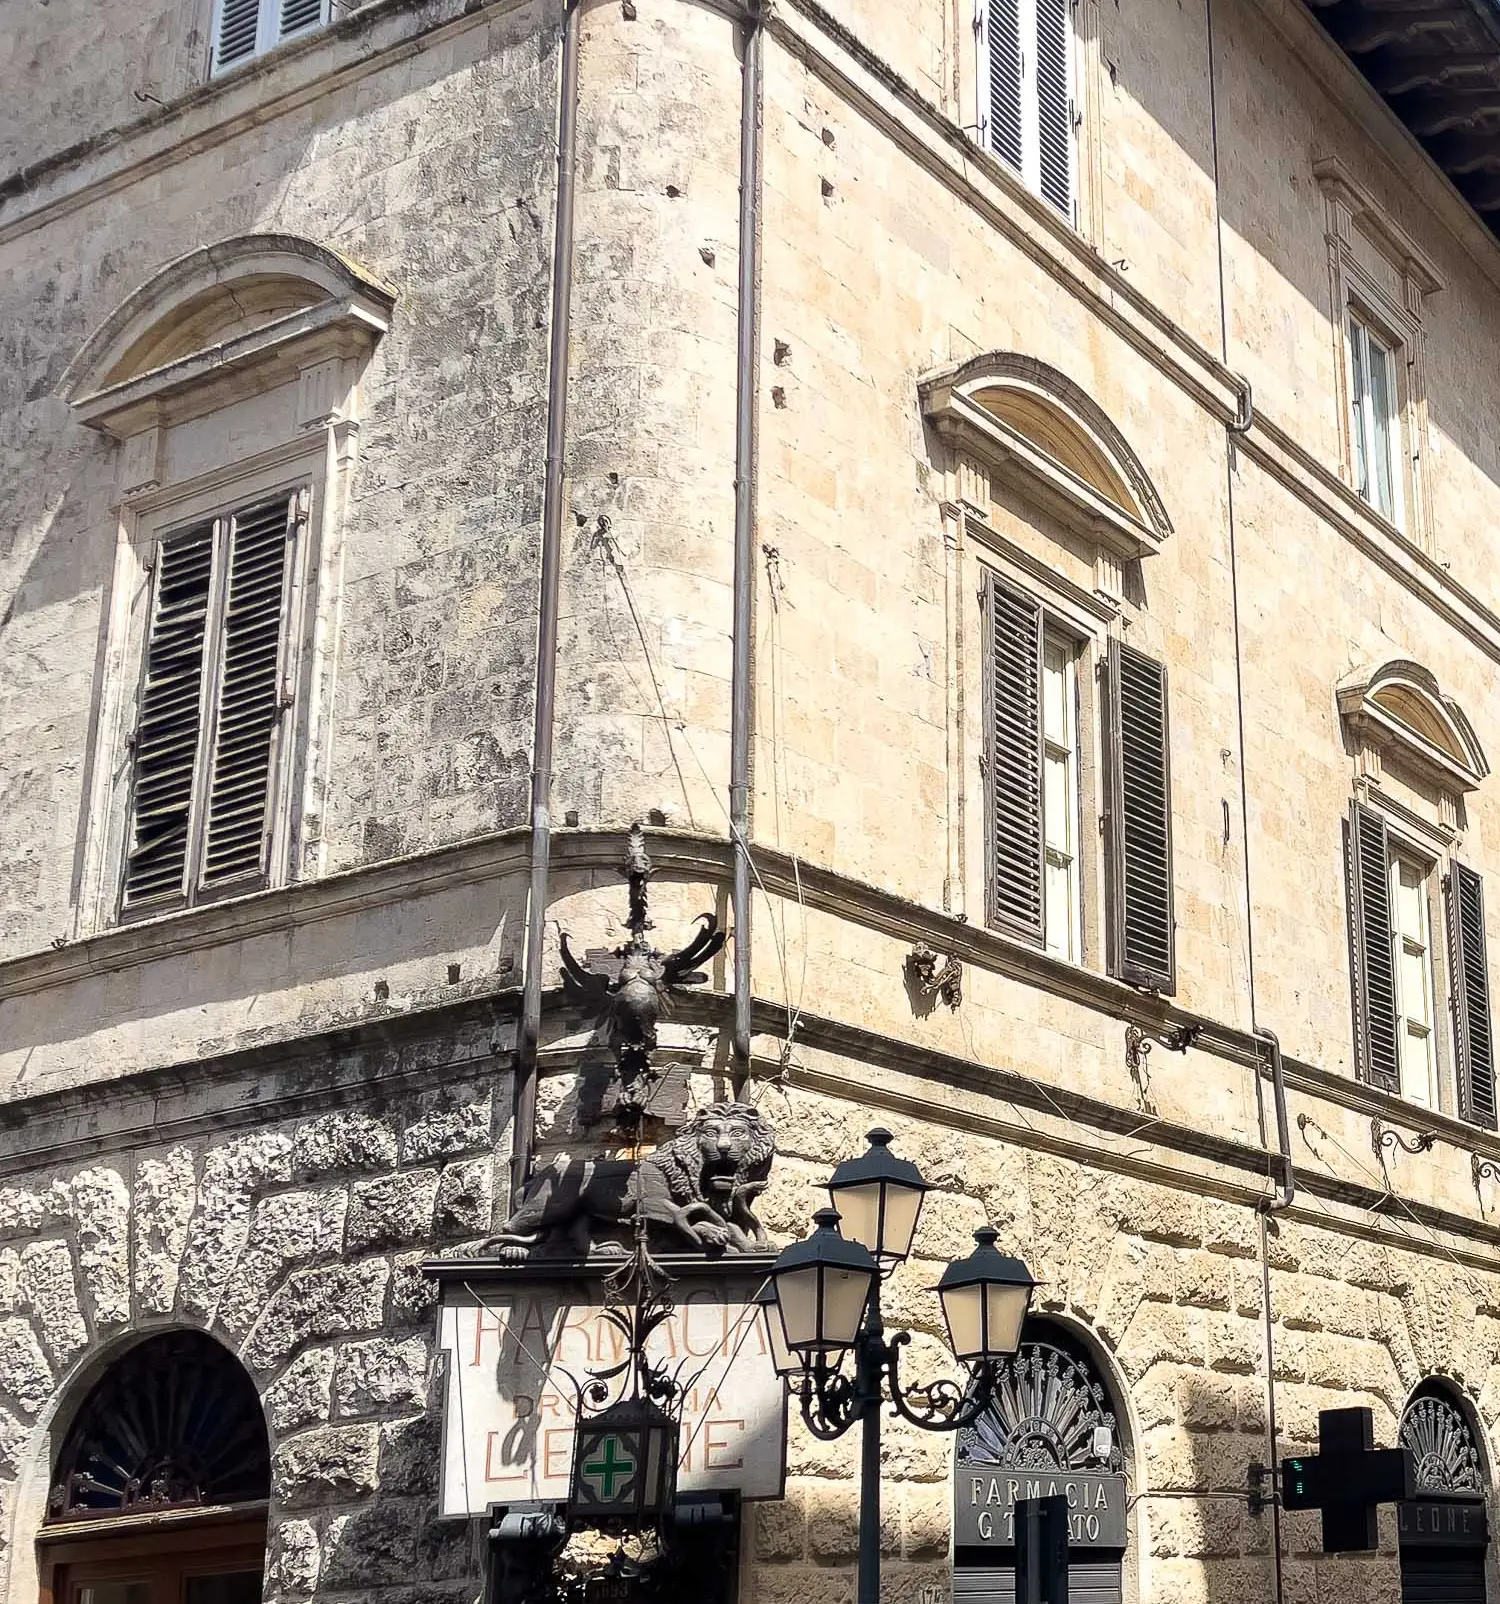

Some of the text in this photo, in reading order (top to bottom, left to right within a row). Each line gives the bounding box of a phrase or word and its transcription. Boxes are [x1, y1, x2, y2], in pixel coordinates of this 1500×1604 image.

[484, 1419, 745, 1482] LEE
[970, 1477, 1109, 1510] FARMACIA
[1400, 1504, 1472, 1533] LEONE
